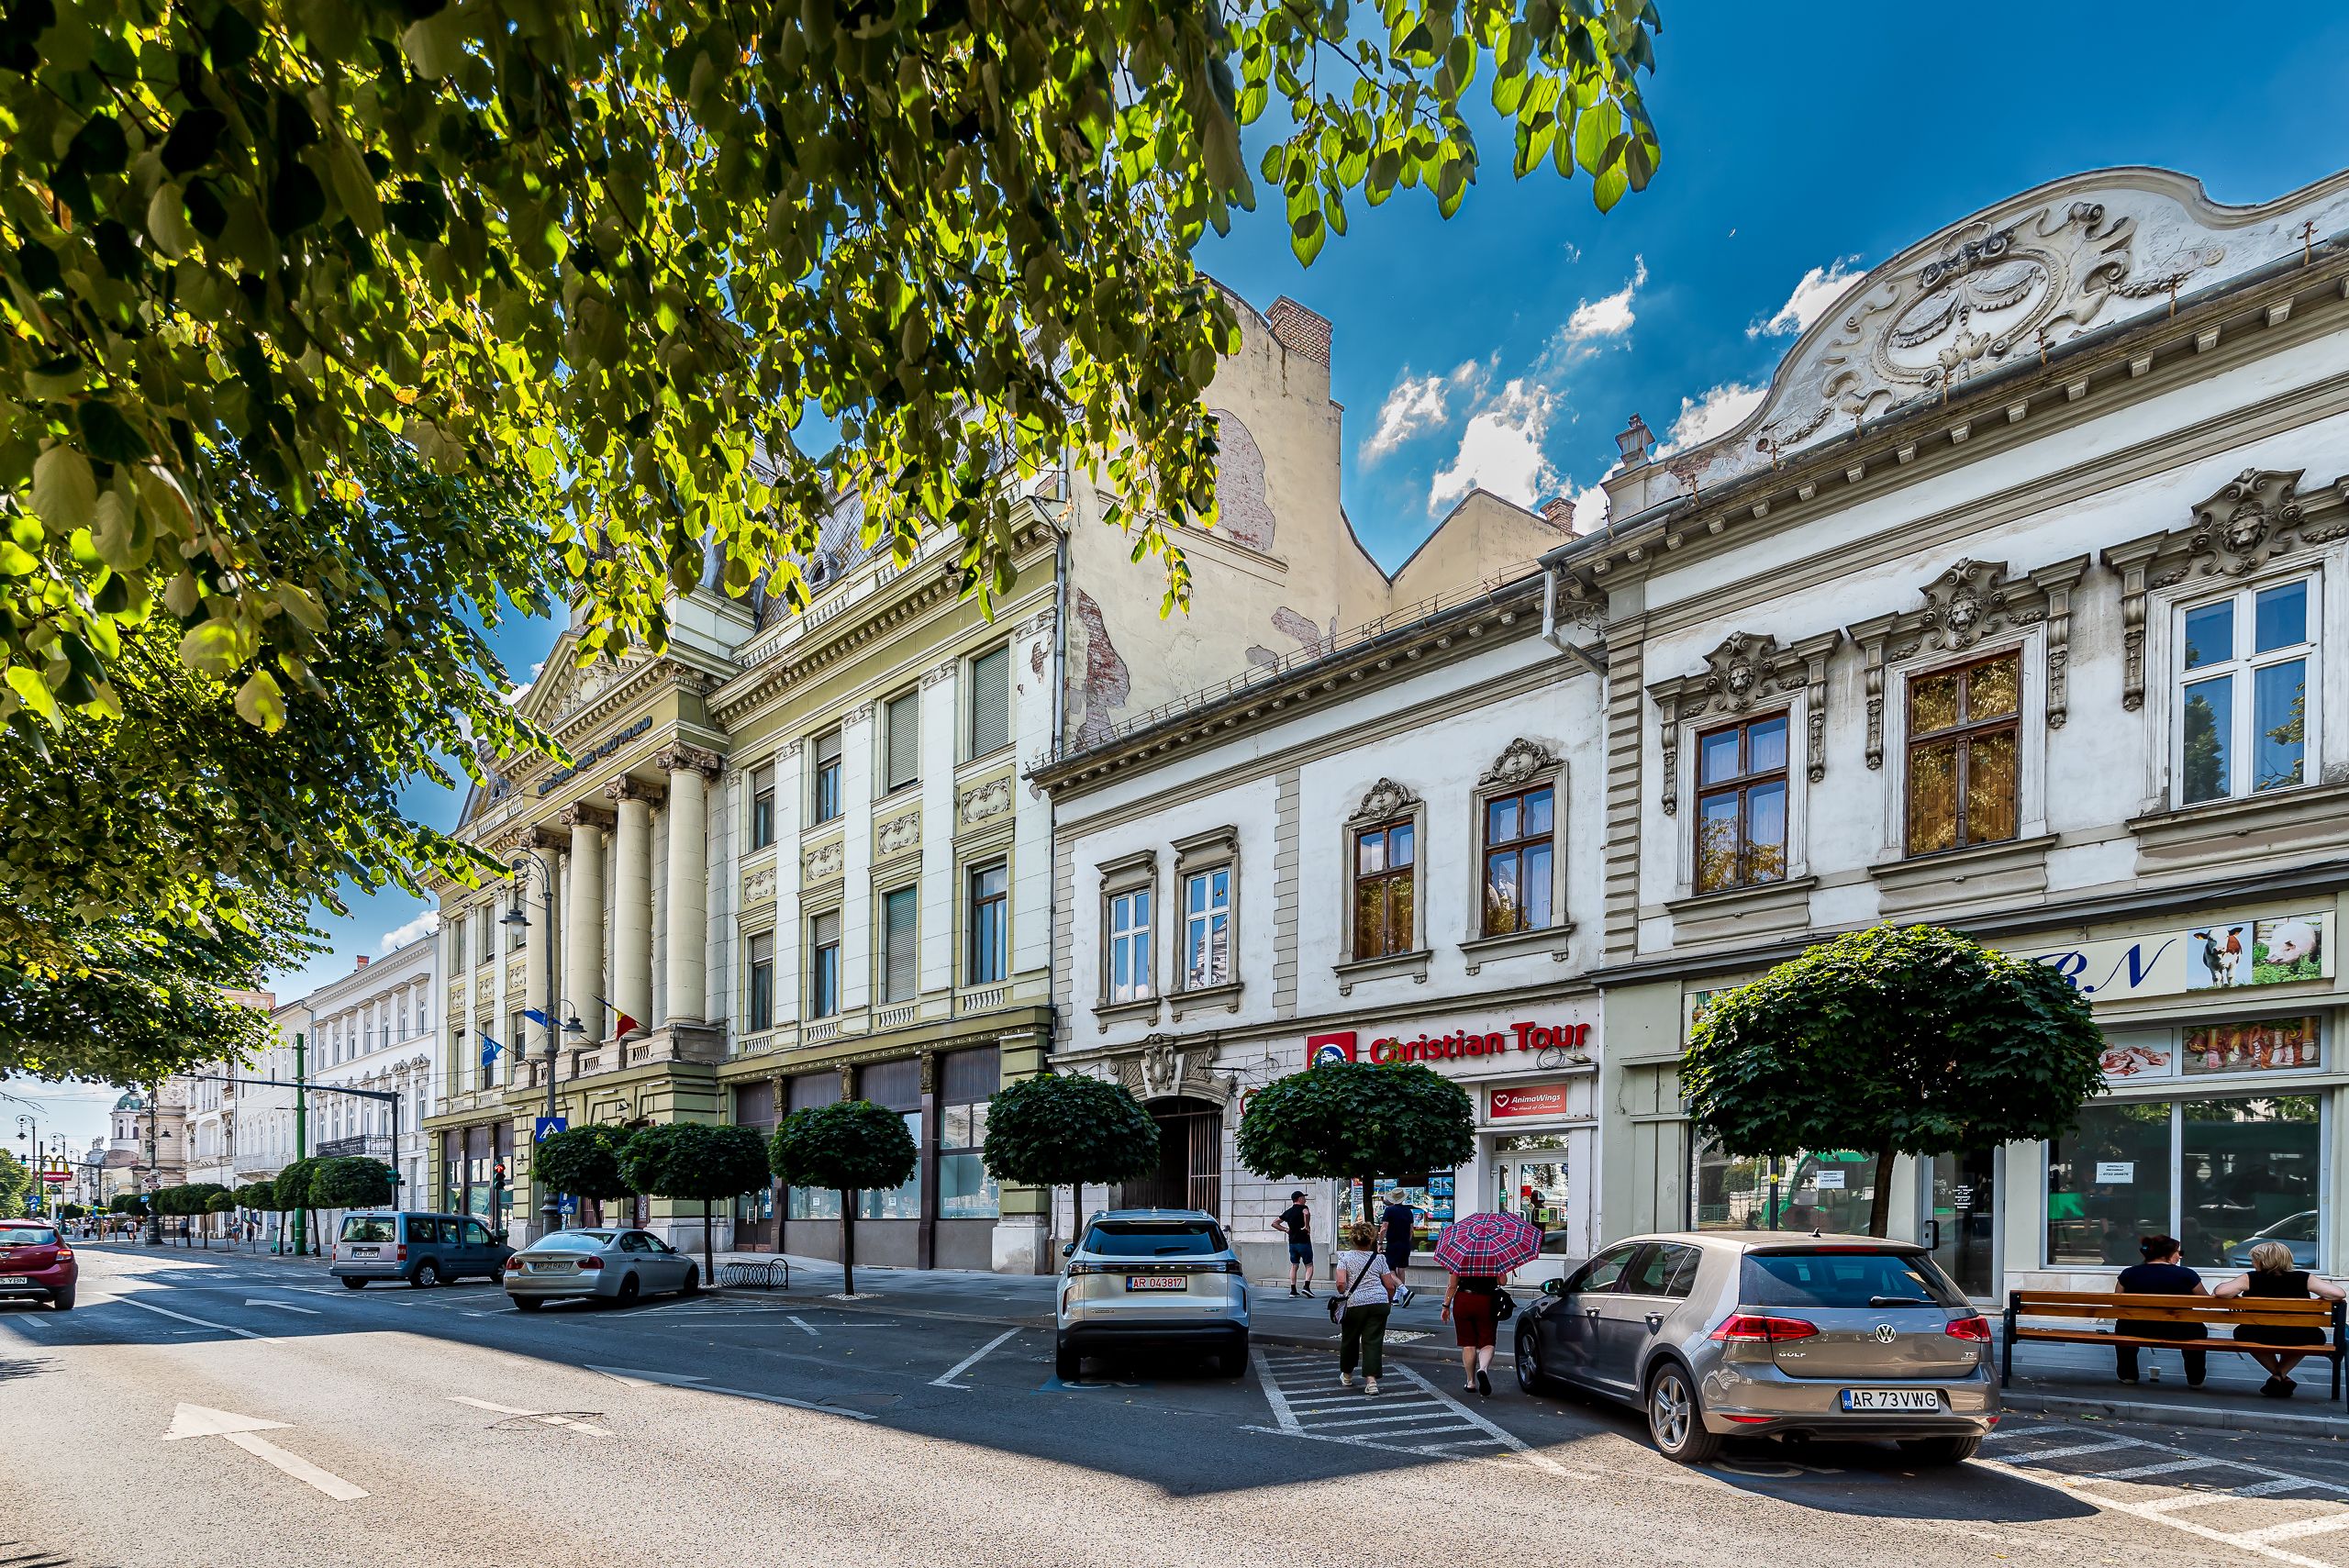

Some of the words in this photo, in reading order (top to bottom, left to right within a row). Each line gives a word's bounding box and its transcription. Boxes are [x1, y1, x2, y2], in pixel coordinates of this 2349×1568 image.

[631, 716, 653, 737] ARAD
[1369, 1029, 1506, 1065] Christian
[1510, 1020, 1591, 1052] Tour
[1511, 1094, 1561, 1104] AnimaWings
[1132, 1278, 1146, 1288] AR
[1149, 1277, 1182, 1288] 043817
[1853, 1392, 1873, 1407] AR
